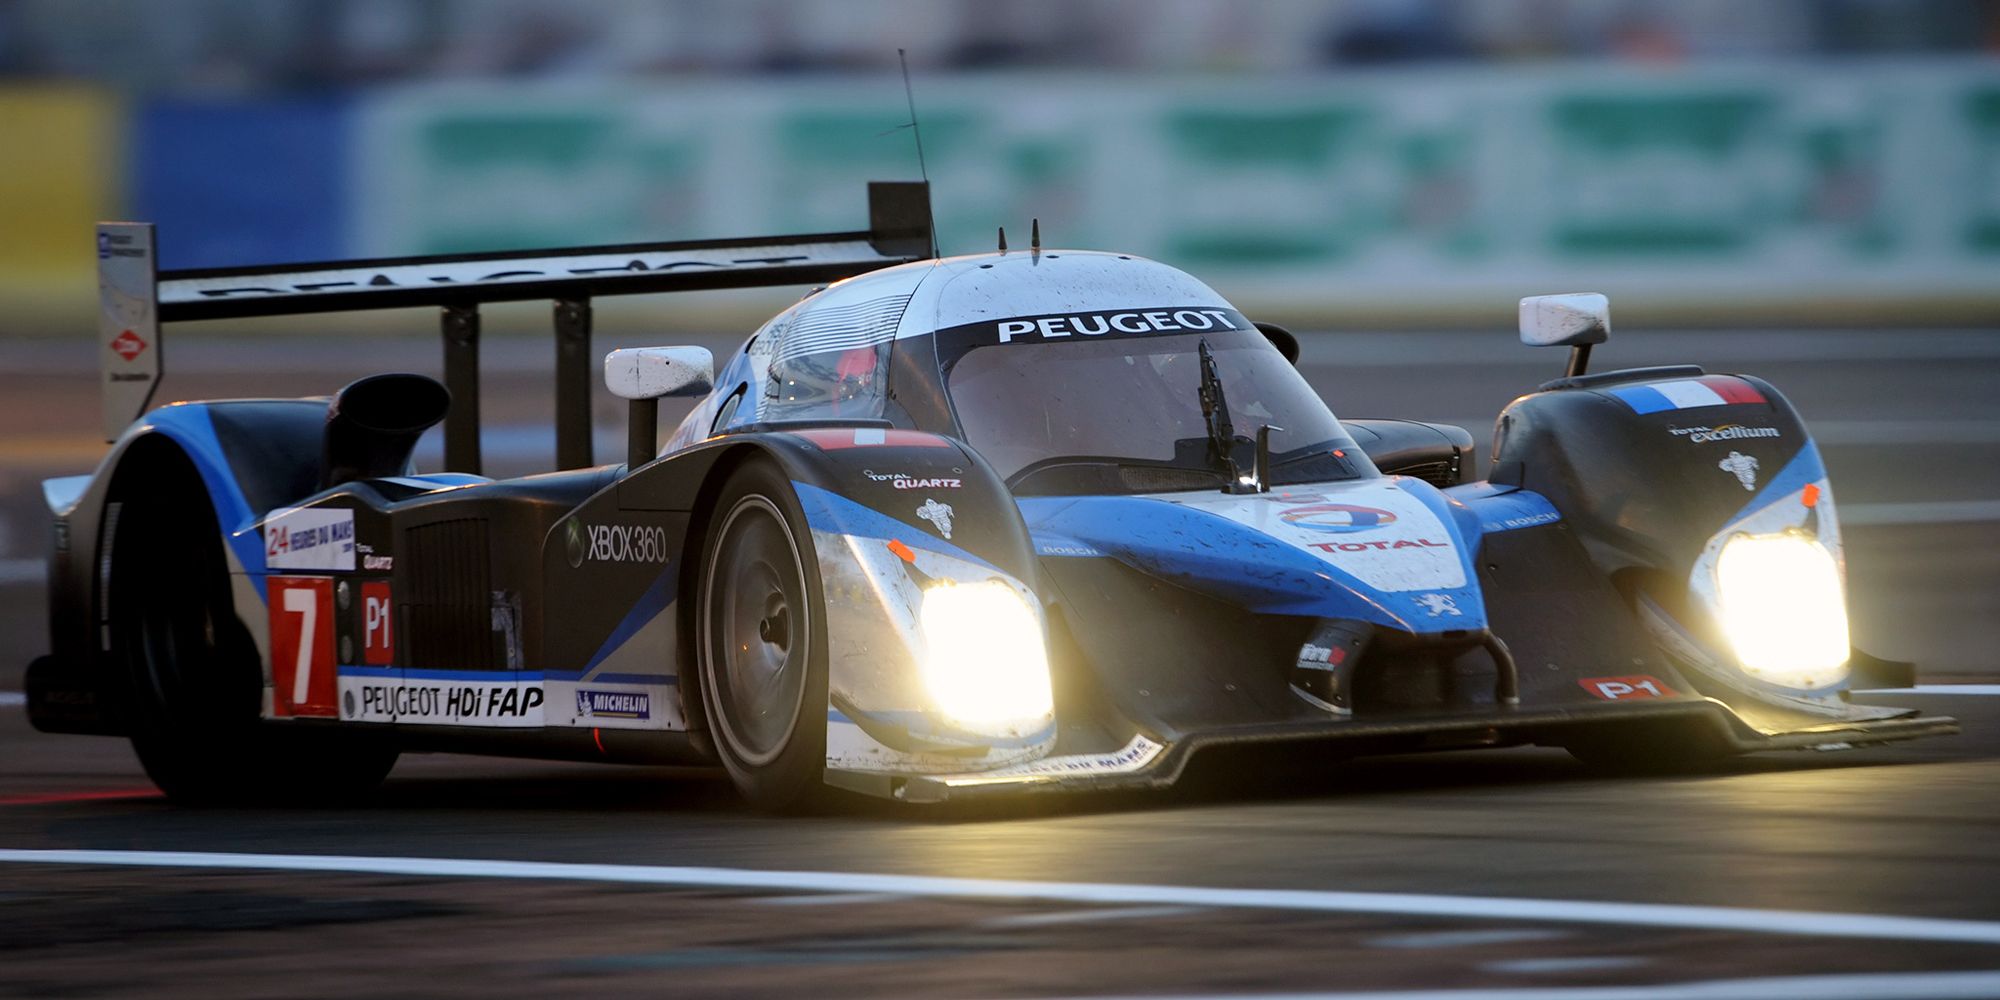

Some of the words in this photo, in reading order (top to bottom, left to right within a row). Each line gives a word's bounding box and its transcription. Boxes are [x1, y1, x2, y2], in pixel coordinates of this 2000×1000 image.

[998, 310, 1236, 343] PEUGEOT
[1690, 427, 1781, 443] excellium
[868, 473, 912, 481] TOTAL
[893, 478, 962, 490] QUARTZ
[1505, 512, 1559, 527] BOSCH
[268, 525, 288, 556] 24
[1307, 538, 1448, 553] TOTAL
[366, 597, 389, 648] P1
[283, 588, 317, 704] 7
[1596, 680, 1662, 699] P1
[362, 686, 440, 716] PEUGEOT
[445, 687, 483, 717] HDi
[487, 687, 544, 717] FAP
[593, 694, 648, 712] MICHELIN
